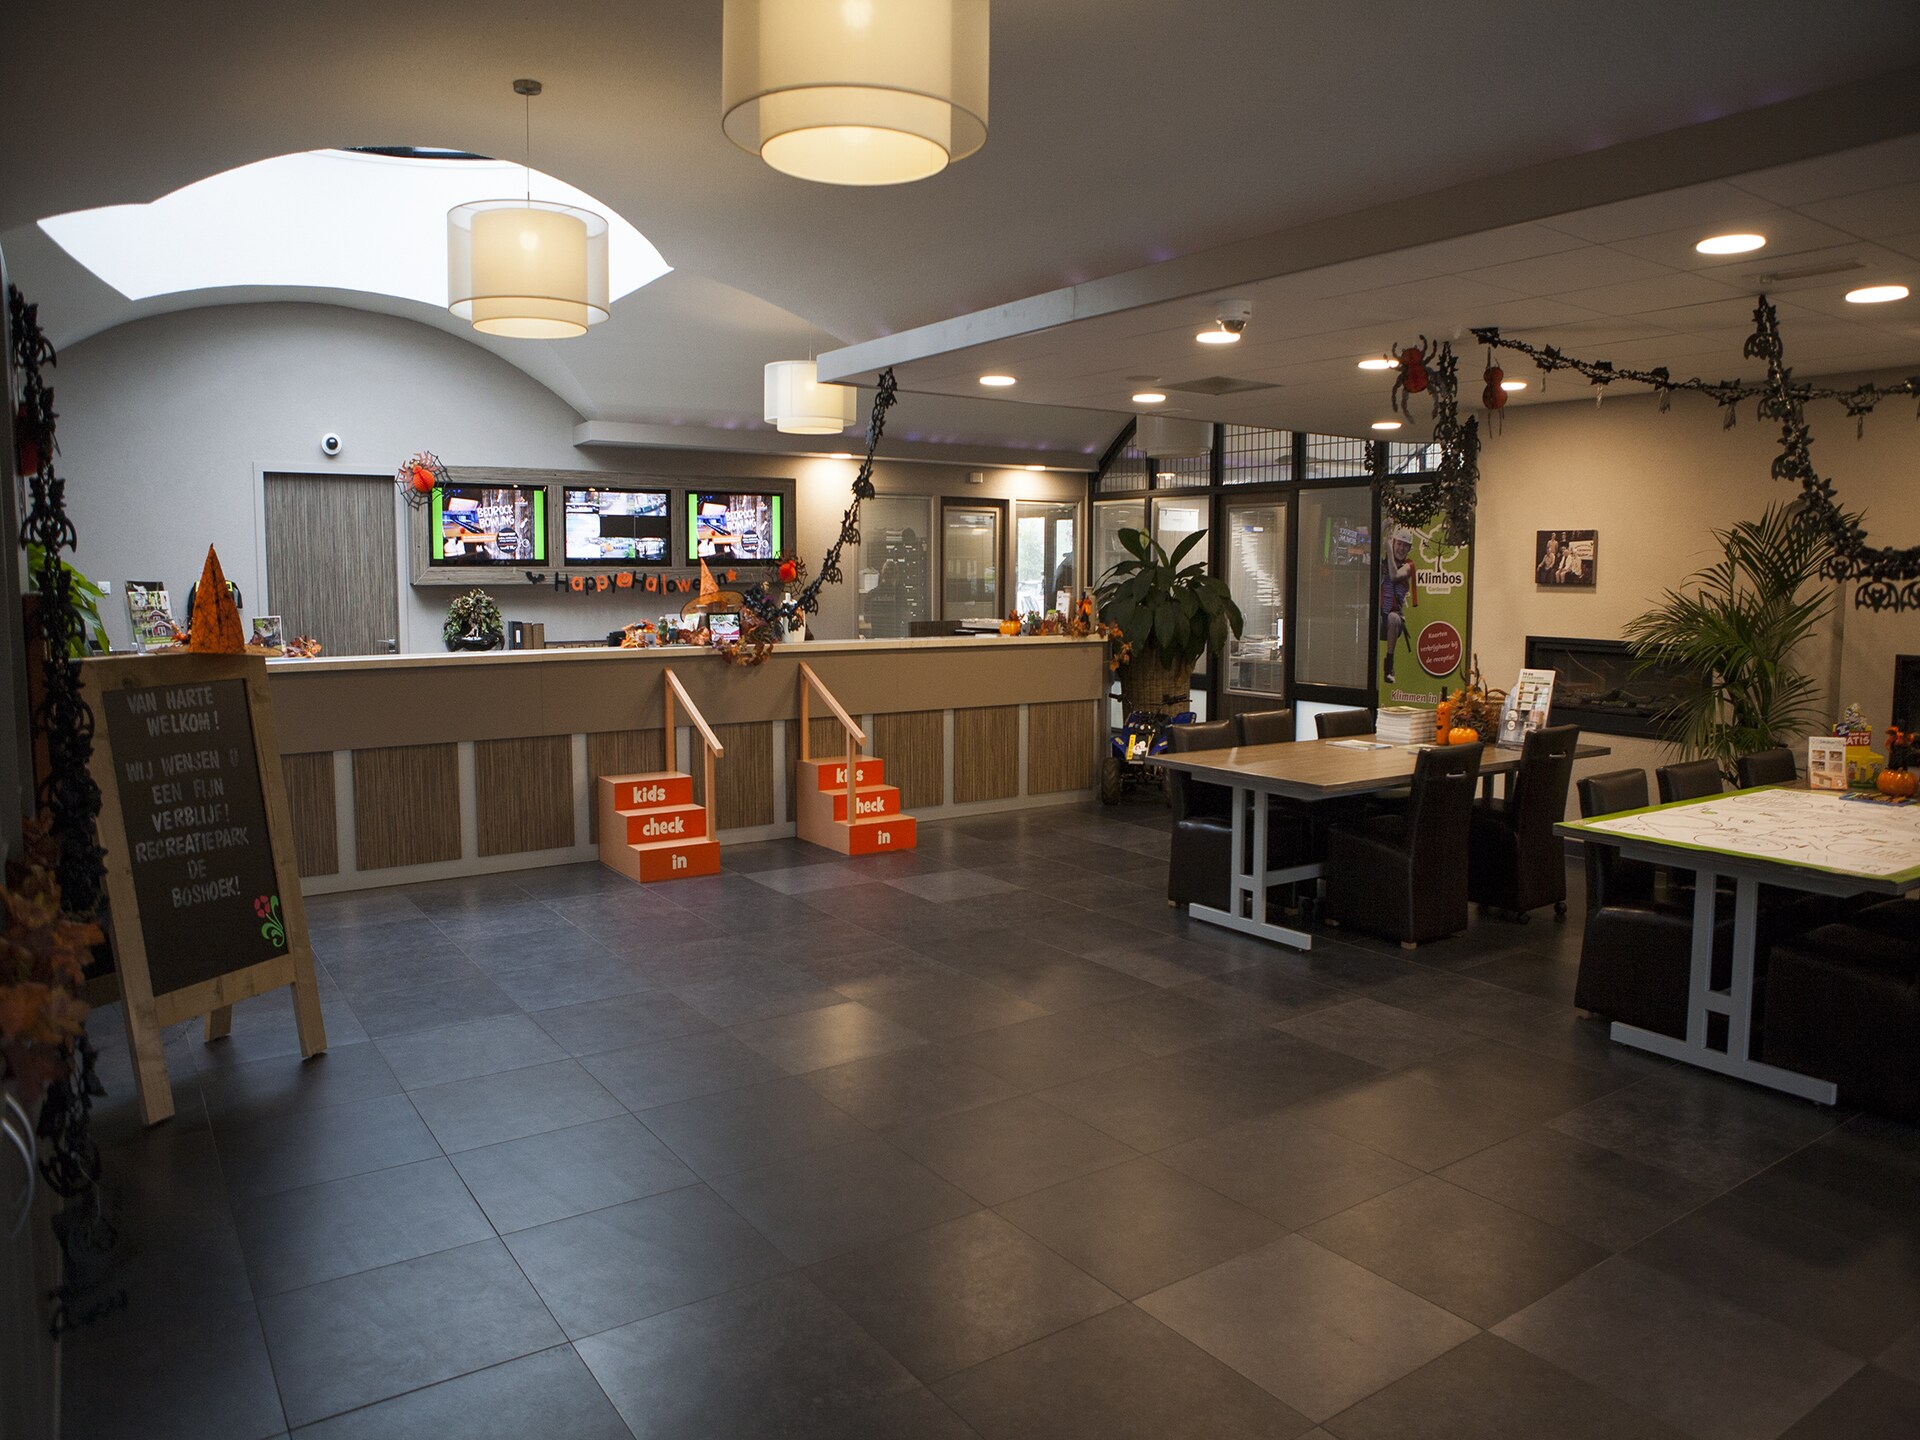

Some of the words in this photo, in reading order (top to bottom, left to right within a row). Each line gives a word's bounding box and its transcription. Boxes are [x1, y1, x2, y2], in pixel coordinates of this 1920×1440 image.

[477, 504, 514, 517] BEDROCK
[479, 514, 515, 528] BOWLING
[554, 571, 617, 595] Happy
[631, 570, 728, 595] Hallowen
[1417, 572, 1462, 584] Klimbos
[127, 691, 157, 714] VAN
[166, 686, 214, 710] HARTE
[1391, 689, 1426, 703] Klimmen
[1428, 691, 1437, 704] in
[125, 760, 154, 783] WIJ
[161, 749, 220, 777] WENSEN
[836, 767, 864, 784] kis
[152, 783, 183, 805] EEN
[193, 777, 225, 799] FIJN
[633, 784, 666, 804] kids
[855, 796, 885, 814] heck
[642, 816, 685, 836] check
[135, 826, 250, 863] RECREATIEPARK
[877, 830, 891, 845] in
[187, 859, 207, 880] DE
[671, 853, 688, 870] in
[171, 875, 241, 908] BOSHOEK!
